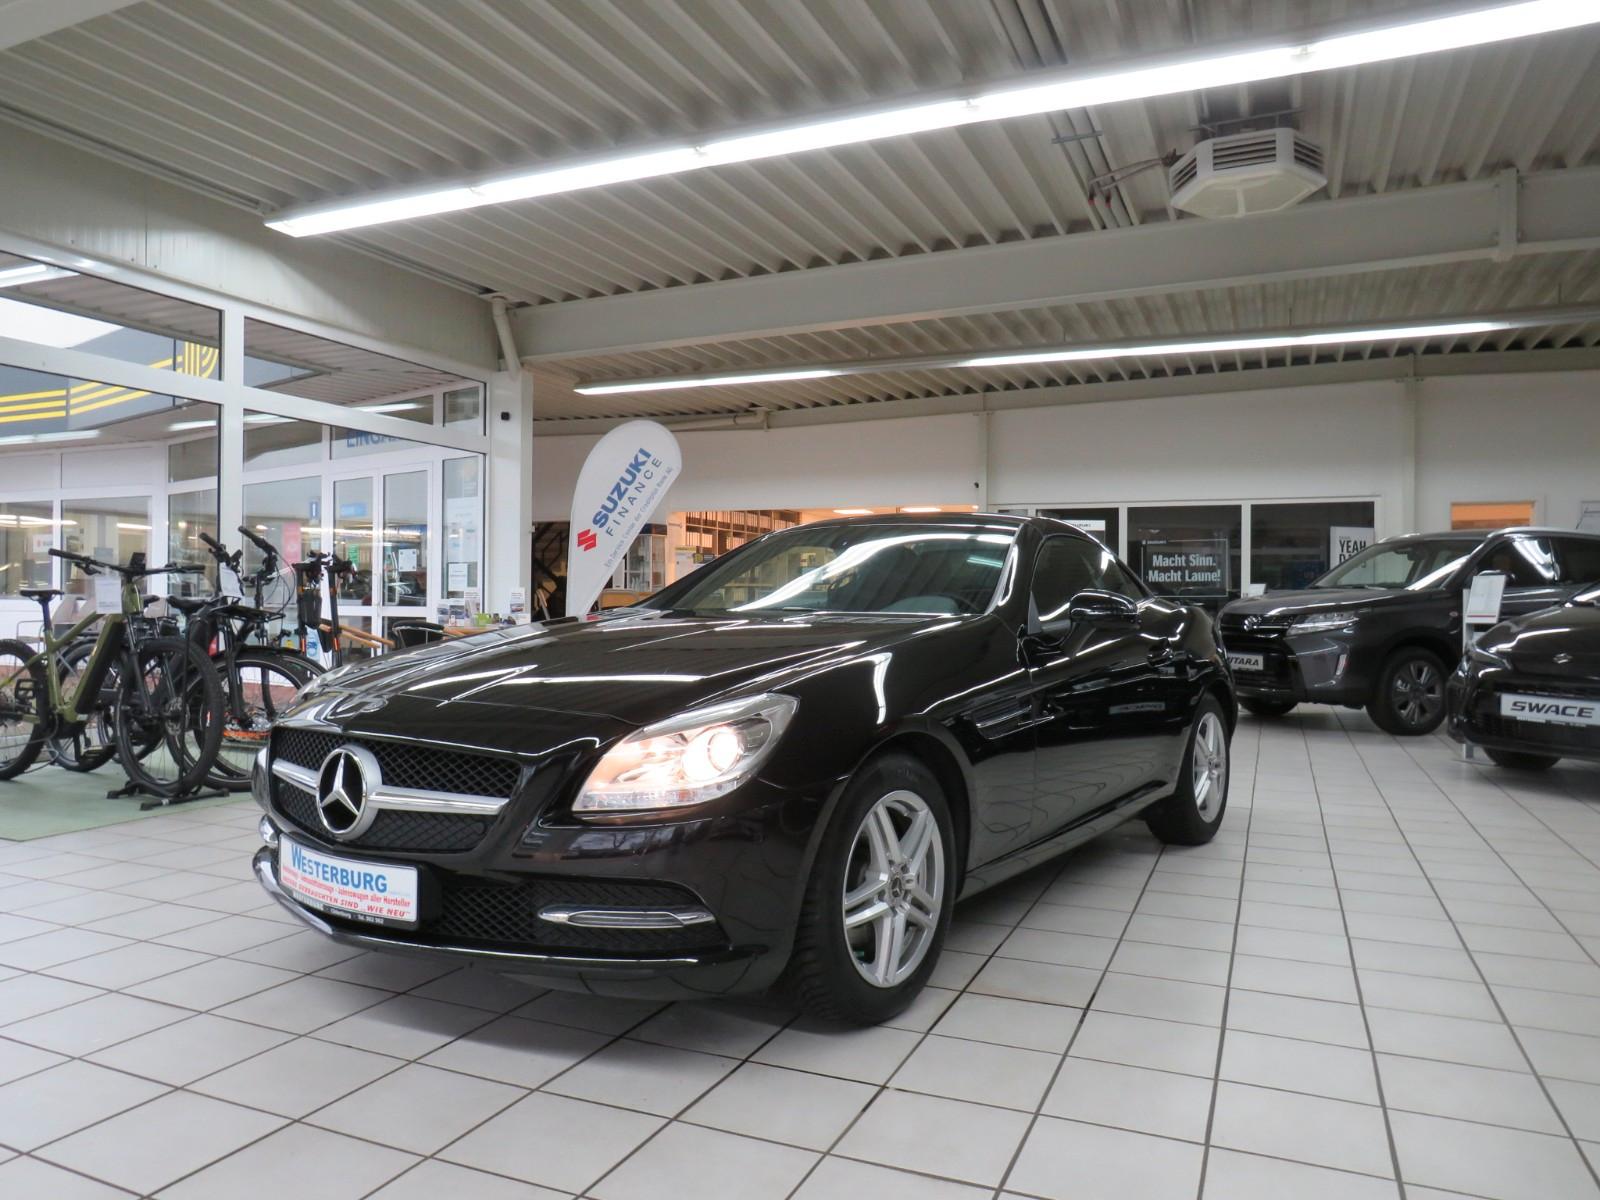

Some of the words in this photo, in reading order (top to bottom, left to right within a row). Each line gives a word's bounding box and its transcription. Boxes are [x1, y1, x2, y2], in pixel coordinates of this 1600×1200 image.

[592, 447, 652, 529] SUZUKI
[605, 458, 662, 536] FINANCE
[1339, 540, 1366, 553] YEAH
[1152, 554, 1186, 567] Macht
[1189, 554, 1216, 566] Sinn.
[1148, 569, 1181, 582] Macht
[1185, 569, 1221, 582] Laune!
[1511, 701, 1595, 718] SWACE
